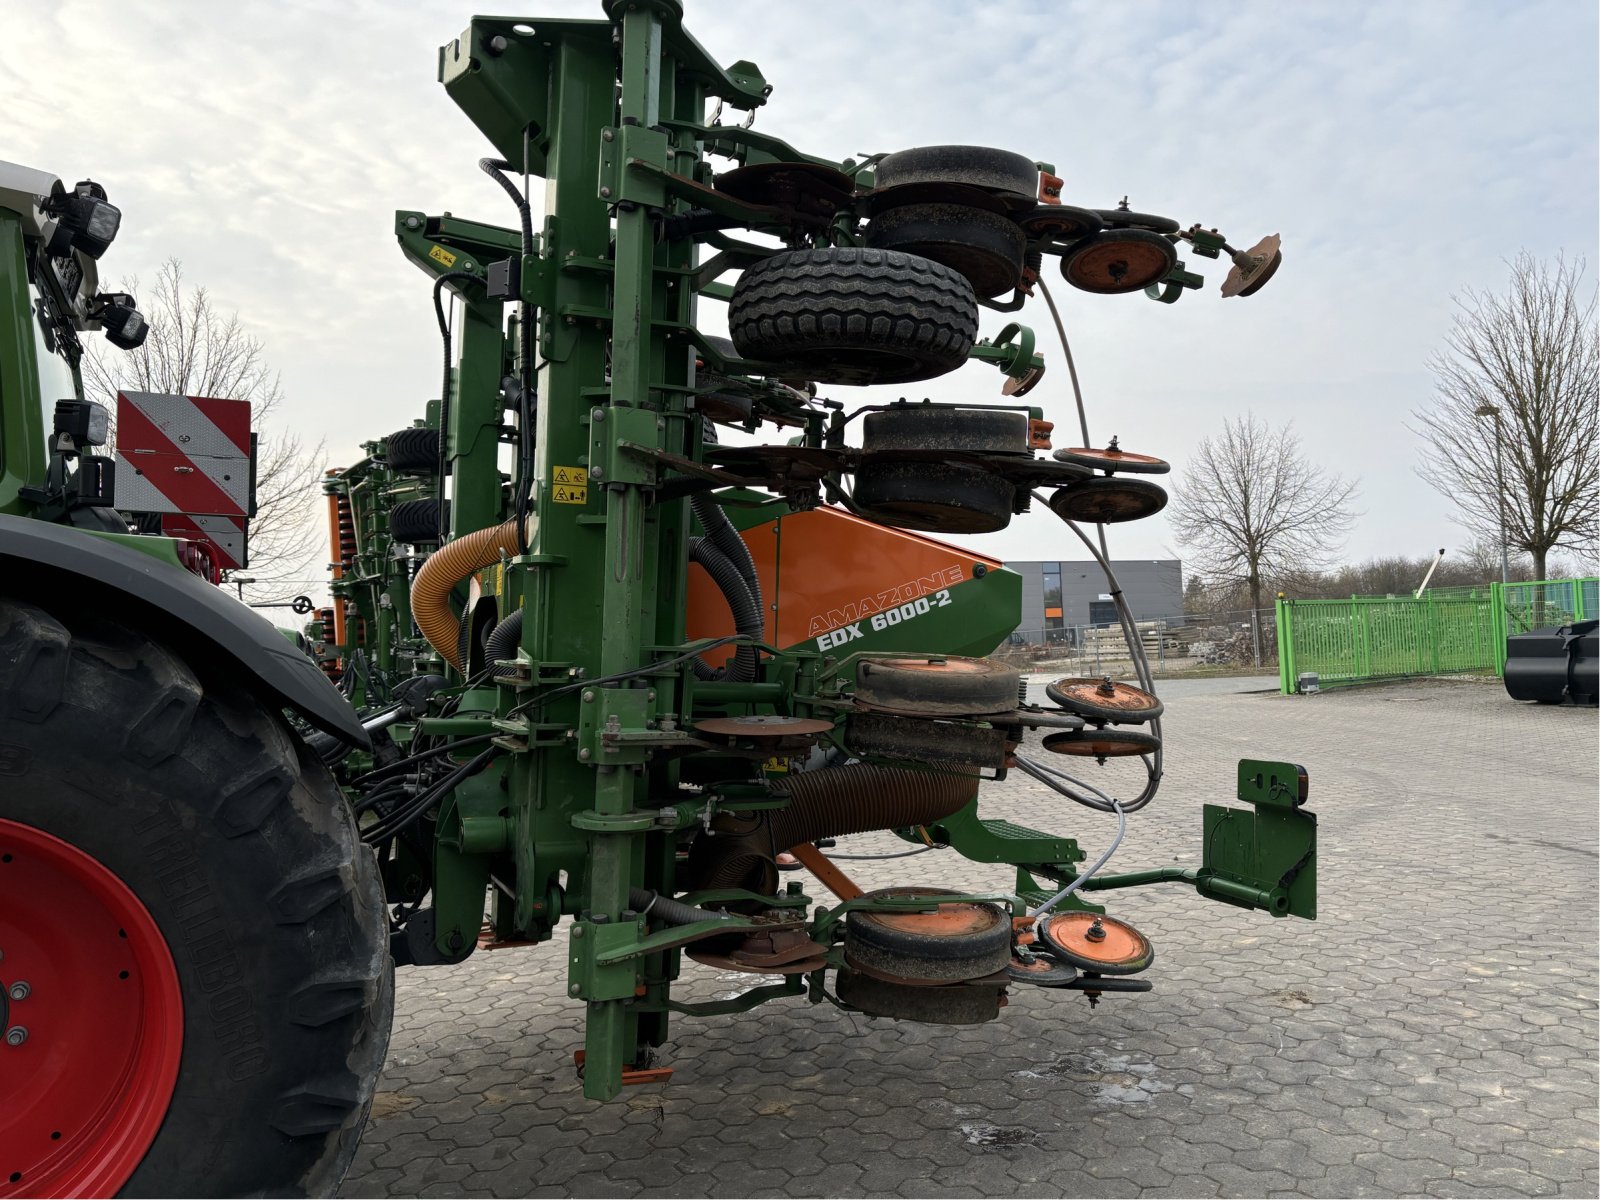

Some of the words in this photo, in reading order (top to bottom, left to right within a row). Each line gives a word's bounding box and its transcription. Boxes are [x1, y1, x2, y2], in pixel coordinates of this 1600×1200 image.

[808, 564, 964, 638] AMAZONE
[816, 622, 864, 652] EDX
[871, 589, 952, 632] 6000-2
[132, 799, 271, 1083] TRELLEBORG
